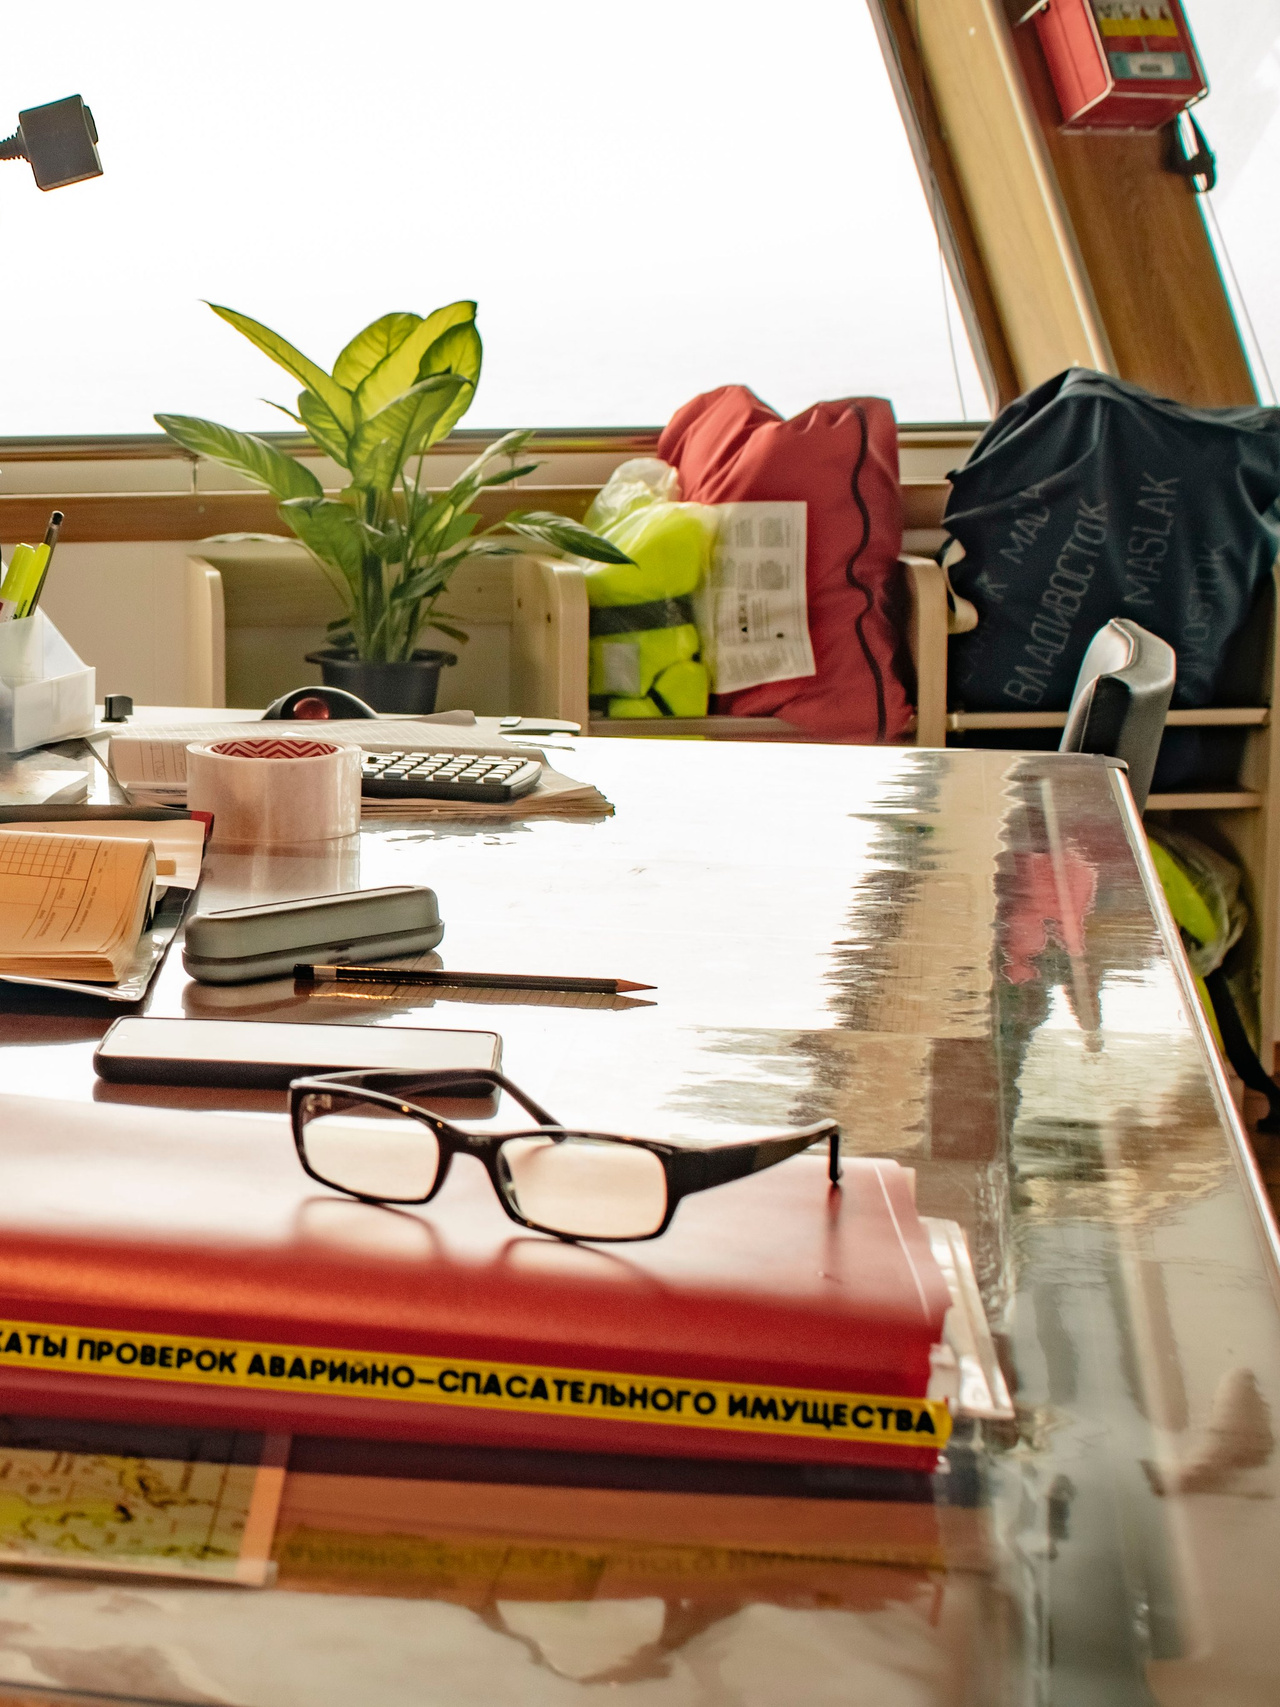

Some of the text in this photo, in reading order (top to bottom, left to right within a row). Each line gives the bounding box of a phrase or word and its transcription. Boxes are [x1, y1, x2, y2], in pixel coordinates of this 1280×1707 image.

[1003, 498, 1110, 706] ВЛАДИВОСТОК
[1123, 471, 1181, 607] MASLAK
[76, 1338, 237, 1374] ПРОВЕРОК
[727, 1394, 937, 1435] ИМУЩЕСТВА
